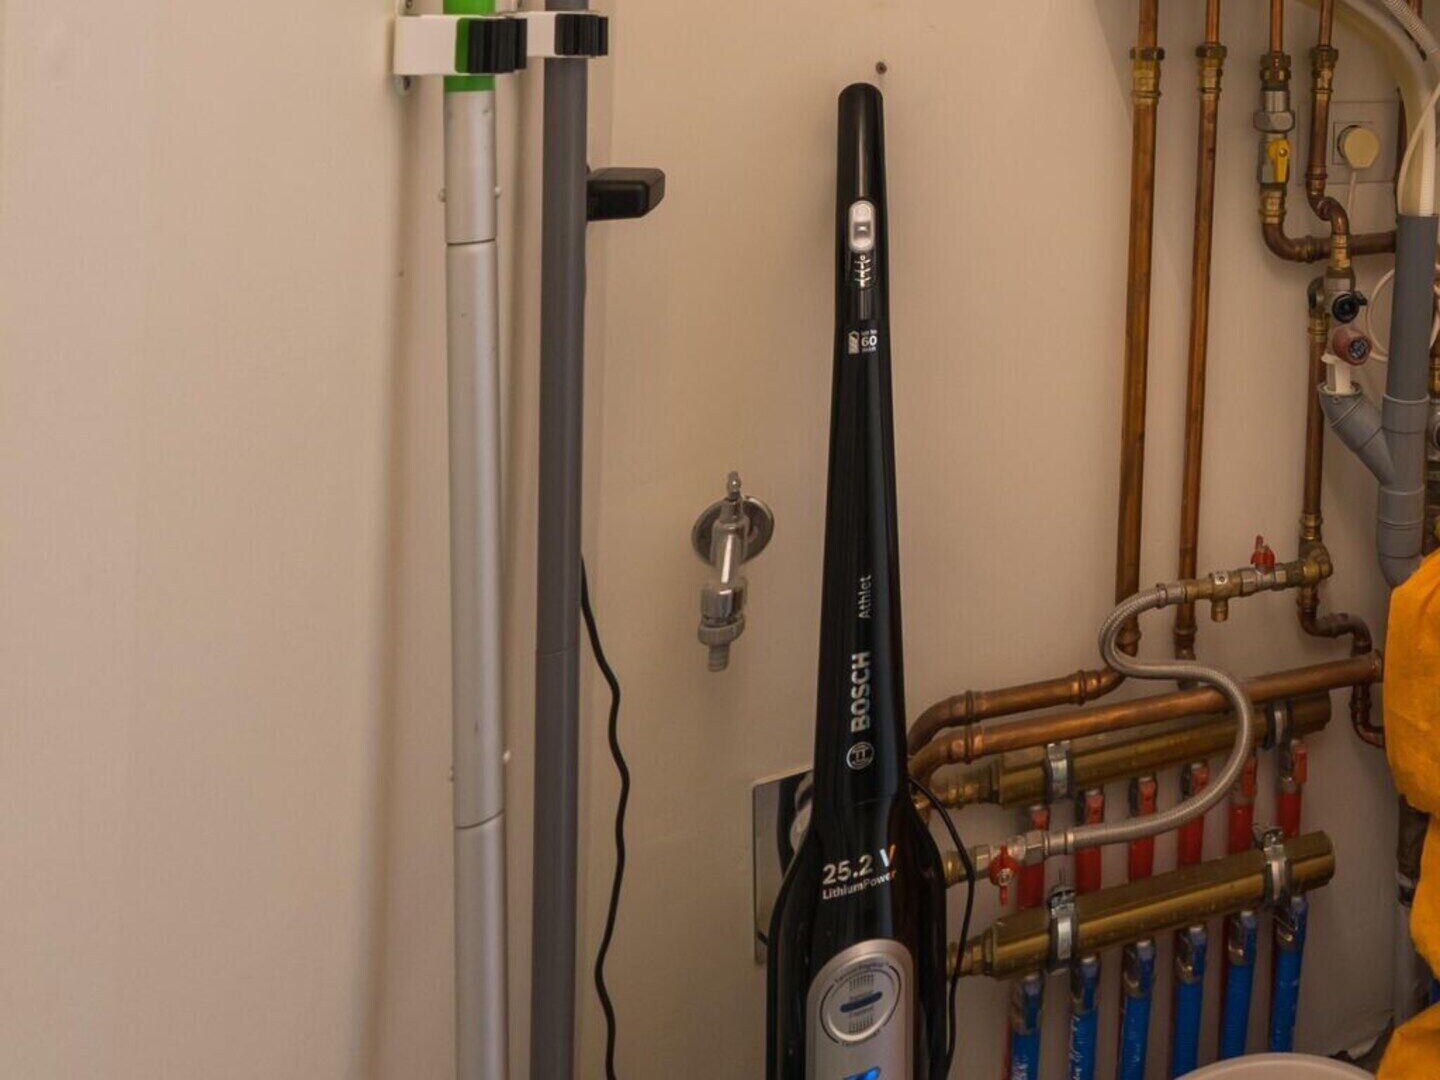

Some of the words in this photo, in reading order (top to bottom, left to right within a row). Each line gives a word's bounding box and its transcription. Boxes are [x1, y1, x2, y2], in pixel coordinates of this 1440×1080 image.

[861, 335, 877, 347] 60
[858, 574, 872, 619] Athlet
[851, 651, 871, 733] BOSCH
[822, 854, 874, 885] 25.2
[880, 844, 897, 867] V
[822, 869, 897, 900] LithiumPower
